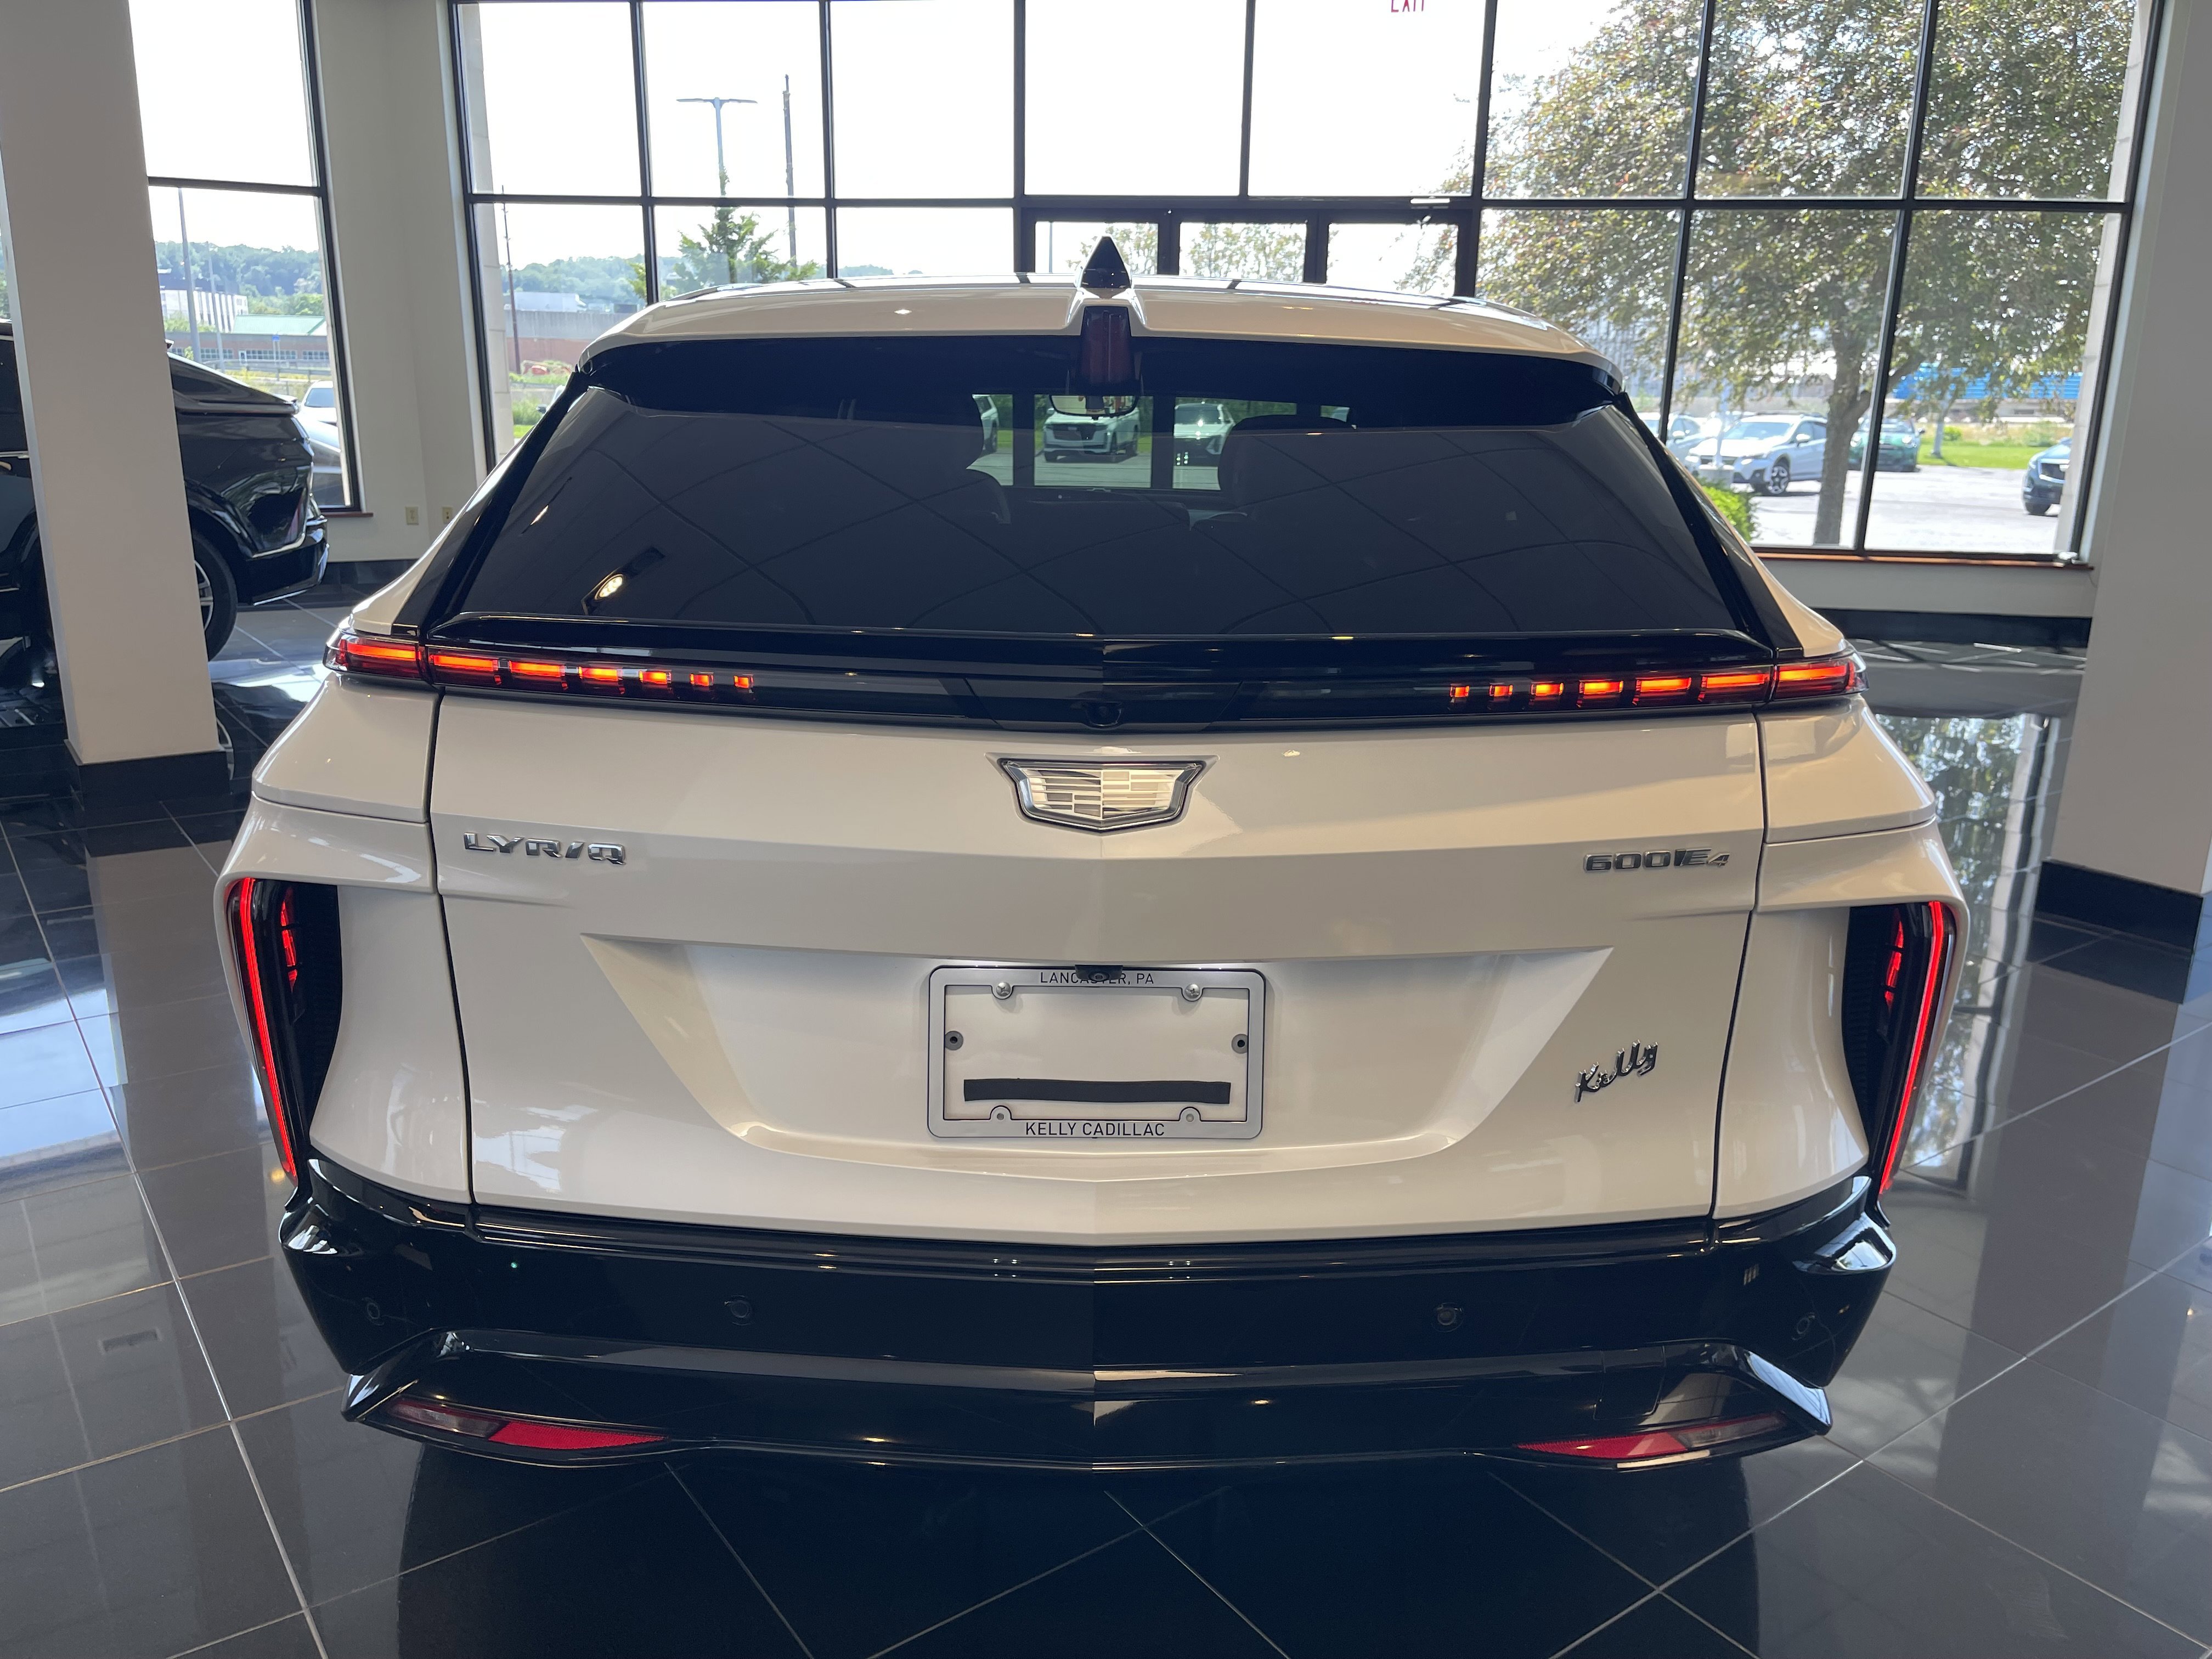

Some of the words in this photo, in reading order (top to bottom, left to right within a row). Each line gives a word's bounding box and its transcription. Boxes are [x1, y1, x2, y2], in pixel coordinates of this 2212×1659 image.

[463, 832, 626, 865] LYRIQ
[1040, 972, 1131, 985] LANCR,
[1137, 973, 1154, 984] PA
[1575, 1039, 1658, 1103] Kelly
[1025, 1122, 1077, 1136] KELLY
[1082, 1122, 1165, 1136] CADILLAC
